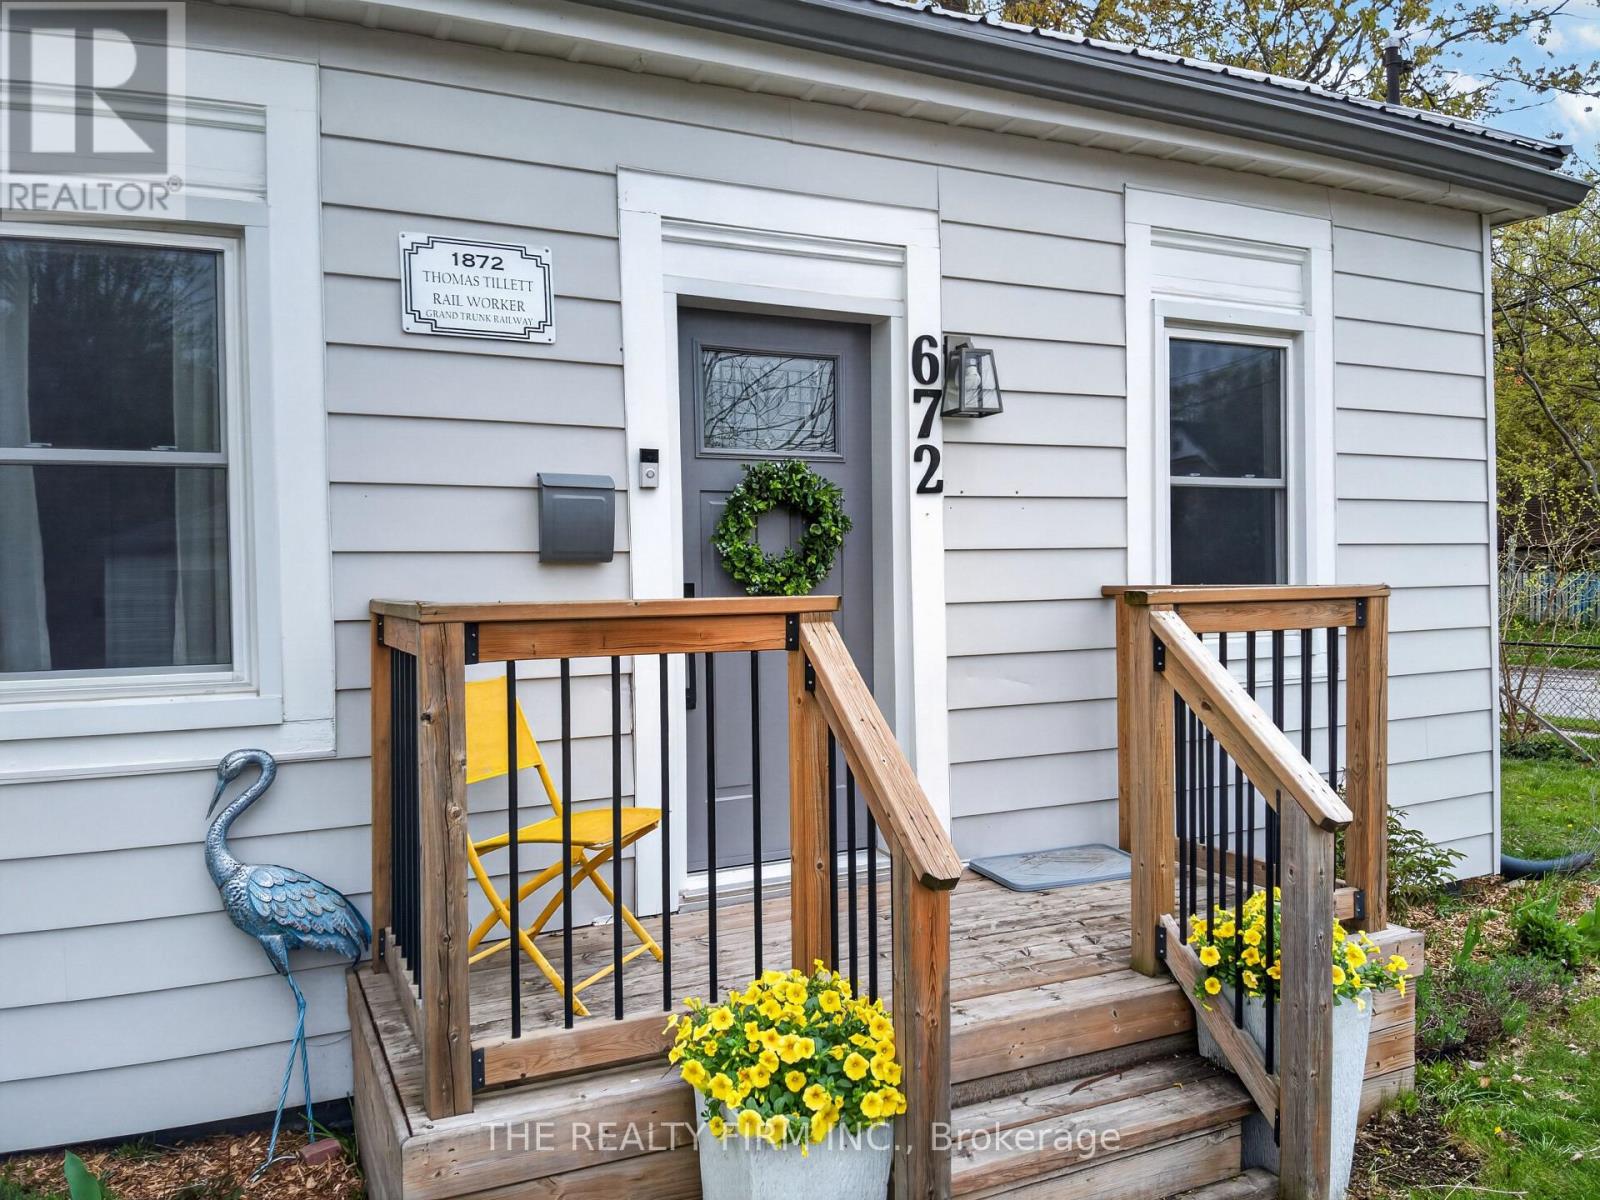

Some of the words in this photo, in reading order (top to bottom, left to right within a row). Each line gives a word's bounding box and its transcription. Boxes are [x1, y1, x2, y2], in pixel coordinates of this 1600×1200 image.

[452, 252, 504, 271] 1872
[423, 270, 480, 287] THOMAS
[483, 276, 534, 292] TILLETT
[433, 292, 464, 307] RAIL
[467, 295, 526, 312] WORKER
[425, 309, 459, 319] GRAND
[461, 312, 492, 323] TRUNK
[493, 315, 534, 326] RAILWAY
[912, 335, 944, 494] 672
